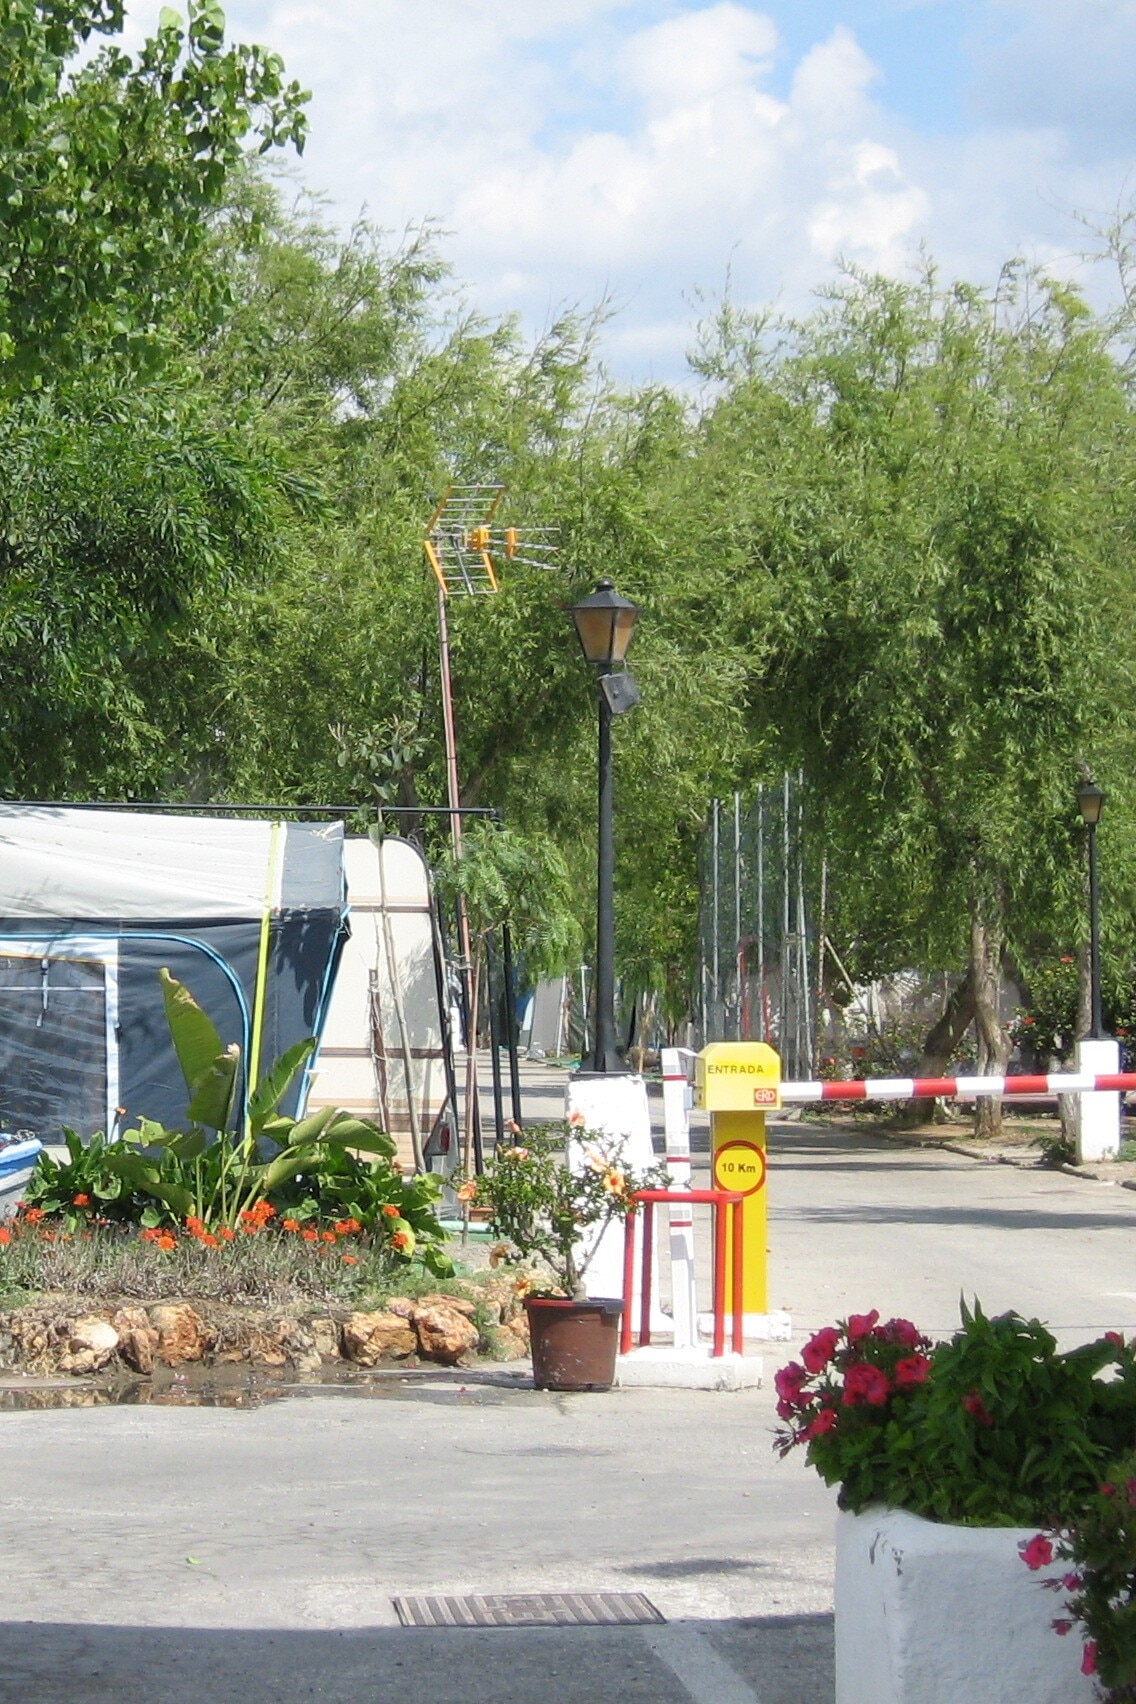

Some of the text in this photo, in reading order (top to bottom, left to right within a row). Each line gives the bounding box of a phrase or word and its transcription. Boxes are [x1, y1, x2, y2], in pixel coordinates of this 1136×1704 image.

[707, 1064, 765, 1074] ENTRADA
[722, 1163, 756, 1173] 10 Km
